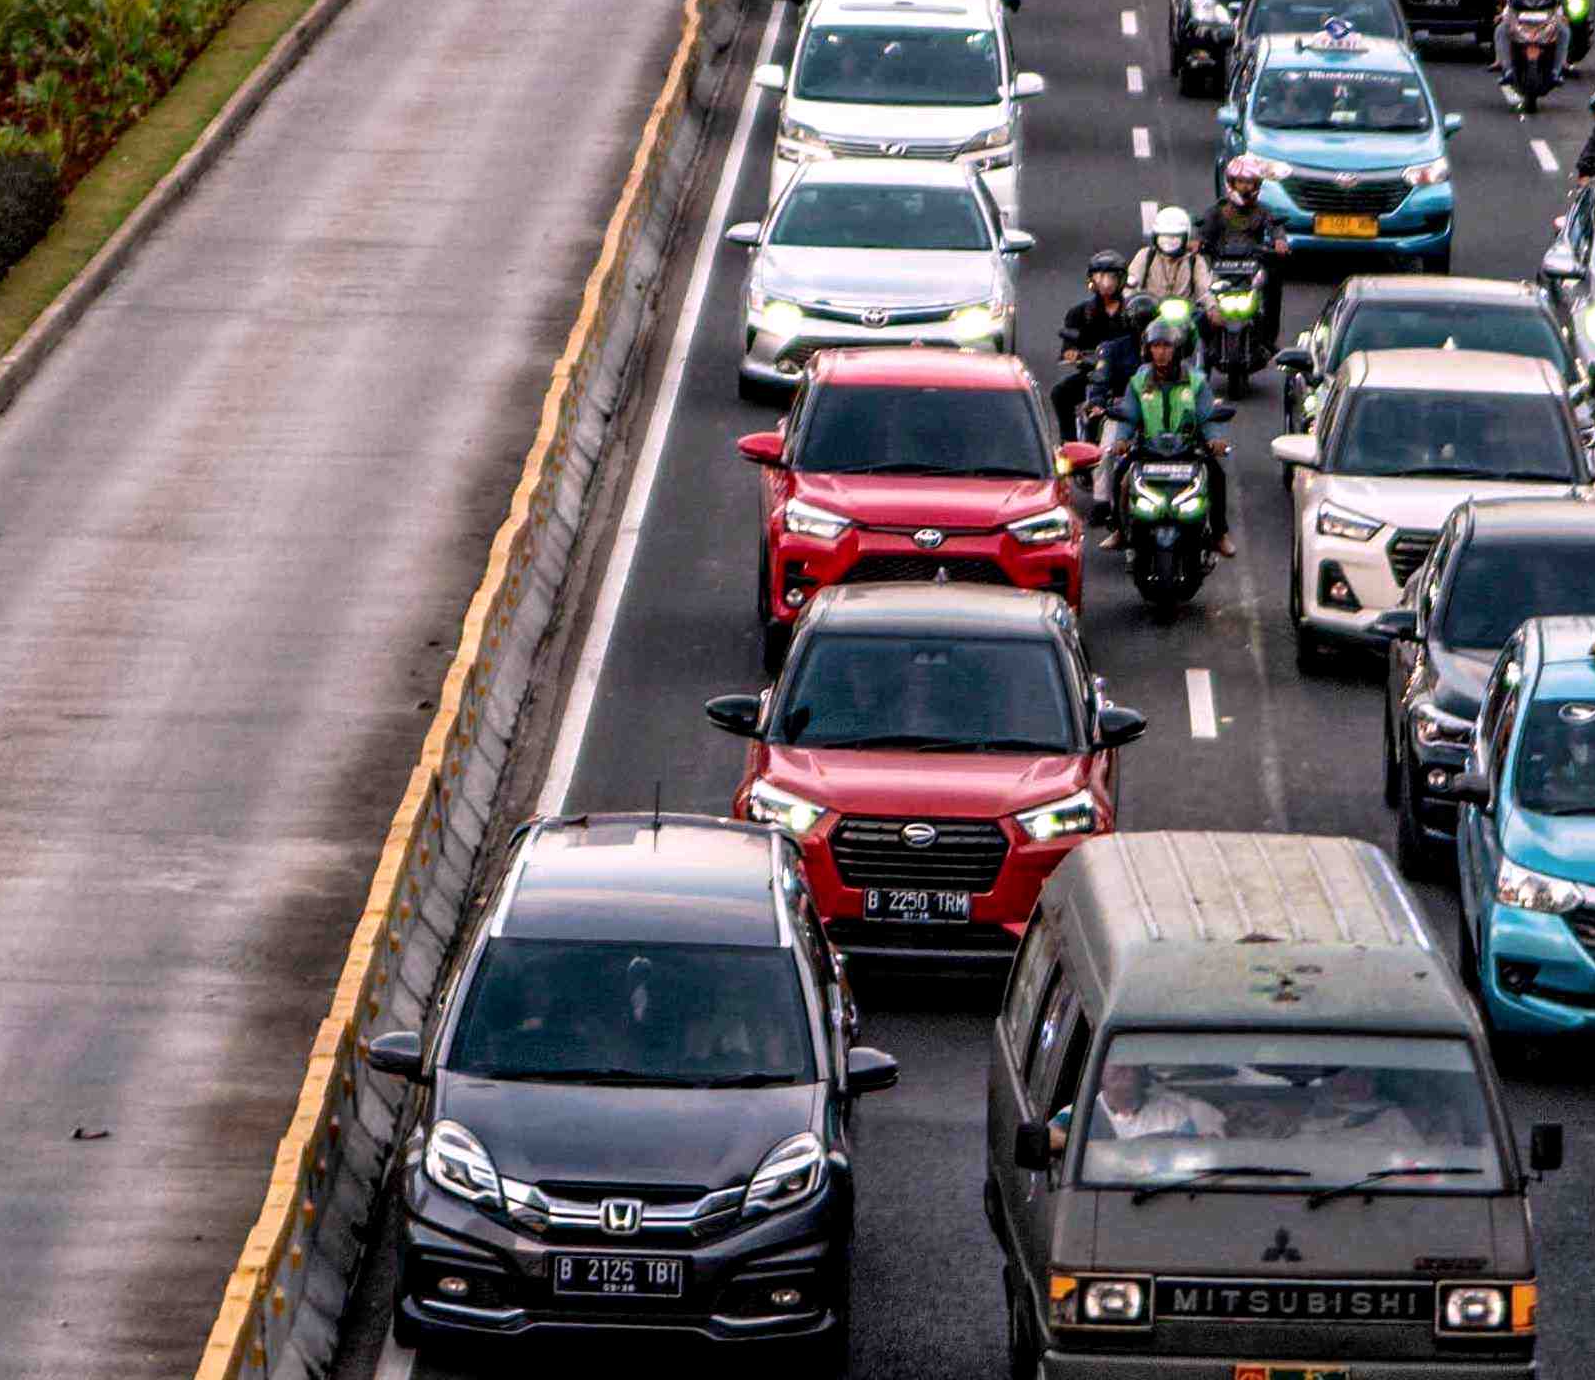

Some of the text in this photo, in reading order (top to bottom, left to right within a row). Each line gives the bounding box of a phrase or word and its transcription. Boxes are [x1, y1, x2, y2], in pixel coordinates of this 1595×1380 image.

[867, 890, 879, 910] B
[889, 891, 928, 911] 2250
[934, 892, 968, 916] TRM
[560, 1258, 678, 1284] B 2125 TBT
[1172, 1287, 1418, 1314] MITSUBISHI
